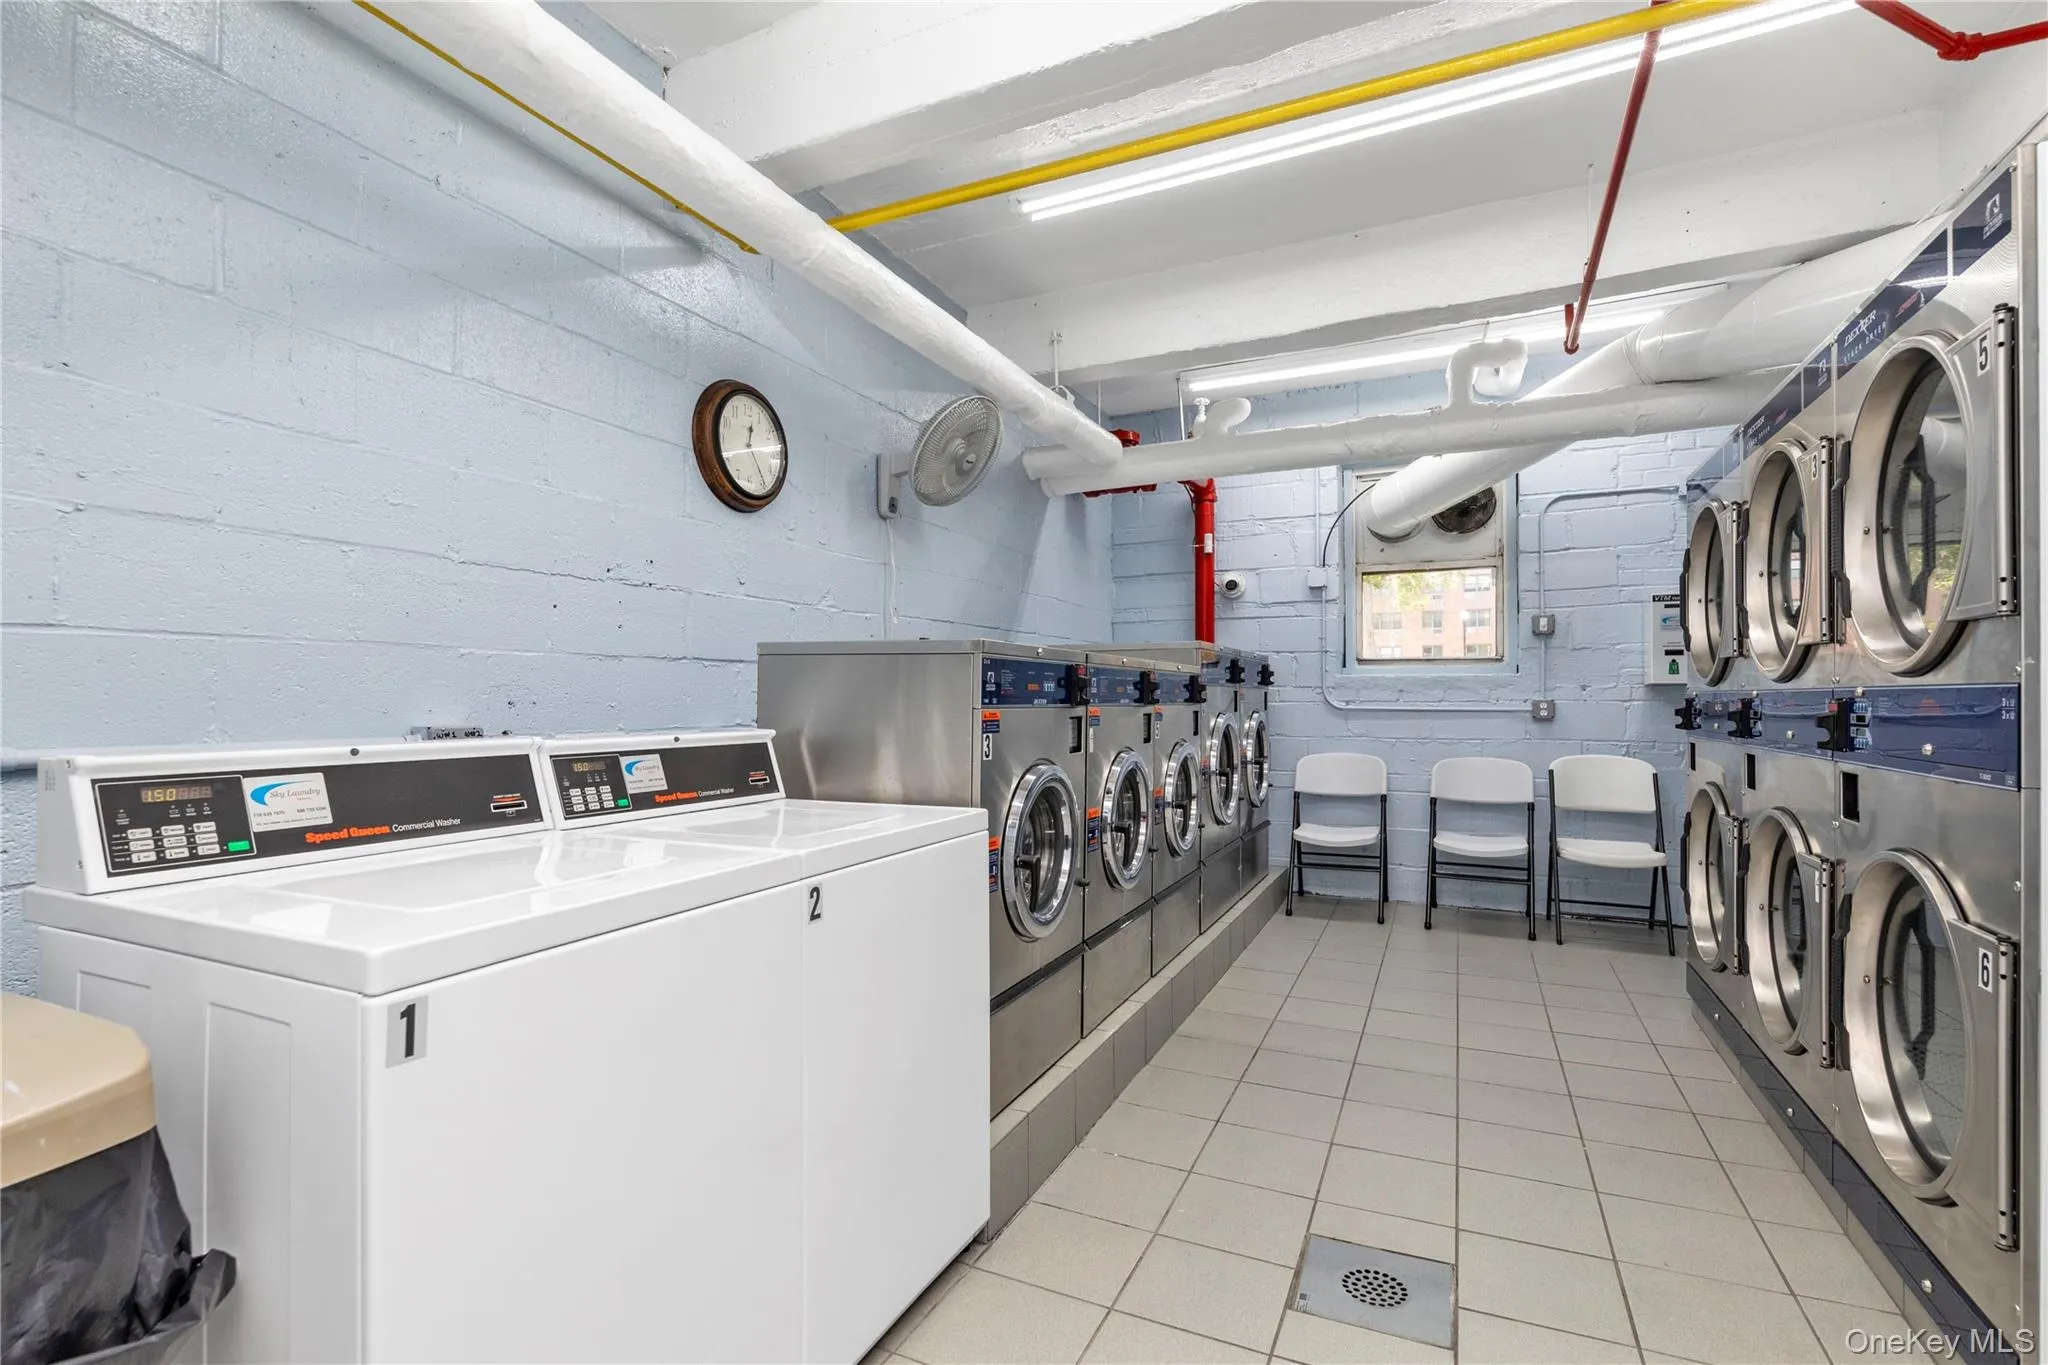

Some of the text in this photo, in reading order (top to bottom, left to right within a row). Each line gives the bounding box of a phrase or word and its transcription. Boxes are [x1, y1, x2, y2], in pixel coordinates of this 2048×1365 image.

[1843, 309, 1877, 348] DEXTER
[1979, 334, 1988, 371] 5
[743, 403, 753, 417] 12
[1812, 453, 1818, 479] 3
[984, 734, 991, 759] 3
[655, 794, 677, 803] Speed
[677, 791, 698, 800] Queen
[305, 817, 461, 844] Speed Queen Commercial Washer
[810, 886, 821, 921] 2
[1981, 952, 1990, 988] 6
[399, 1002, 416, 1059] 1
